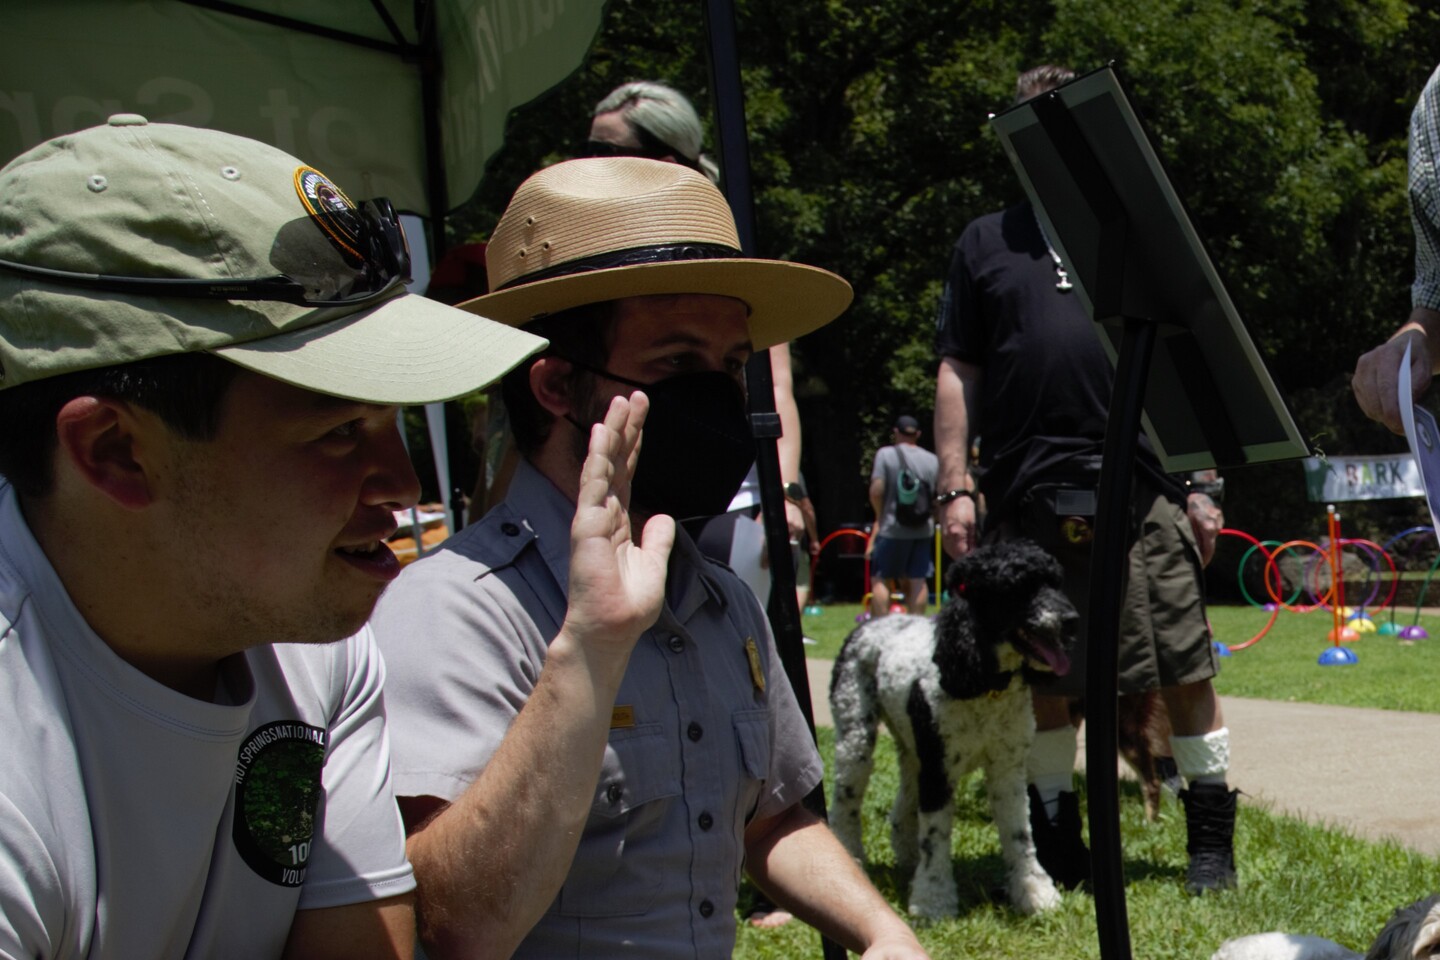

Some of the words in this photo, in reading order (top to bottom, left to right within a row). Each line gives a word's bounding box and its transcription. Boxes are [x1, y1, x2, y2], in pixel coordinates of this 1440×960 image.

[1345, 462, 1404, 487] BARK
[240, 727, 277, 764] SPRINGS
[275, 725, 325, 745] NATIONAL
[288, 839, 312, 865] 10
